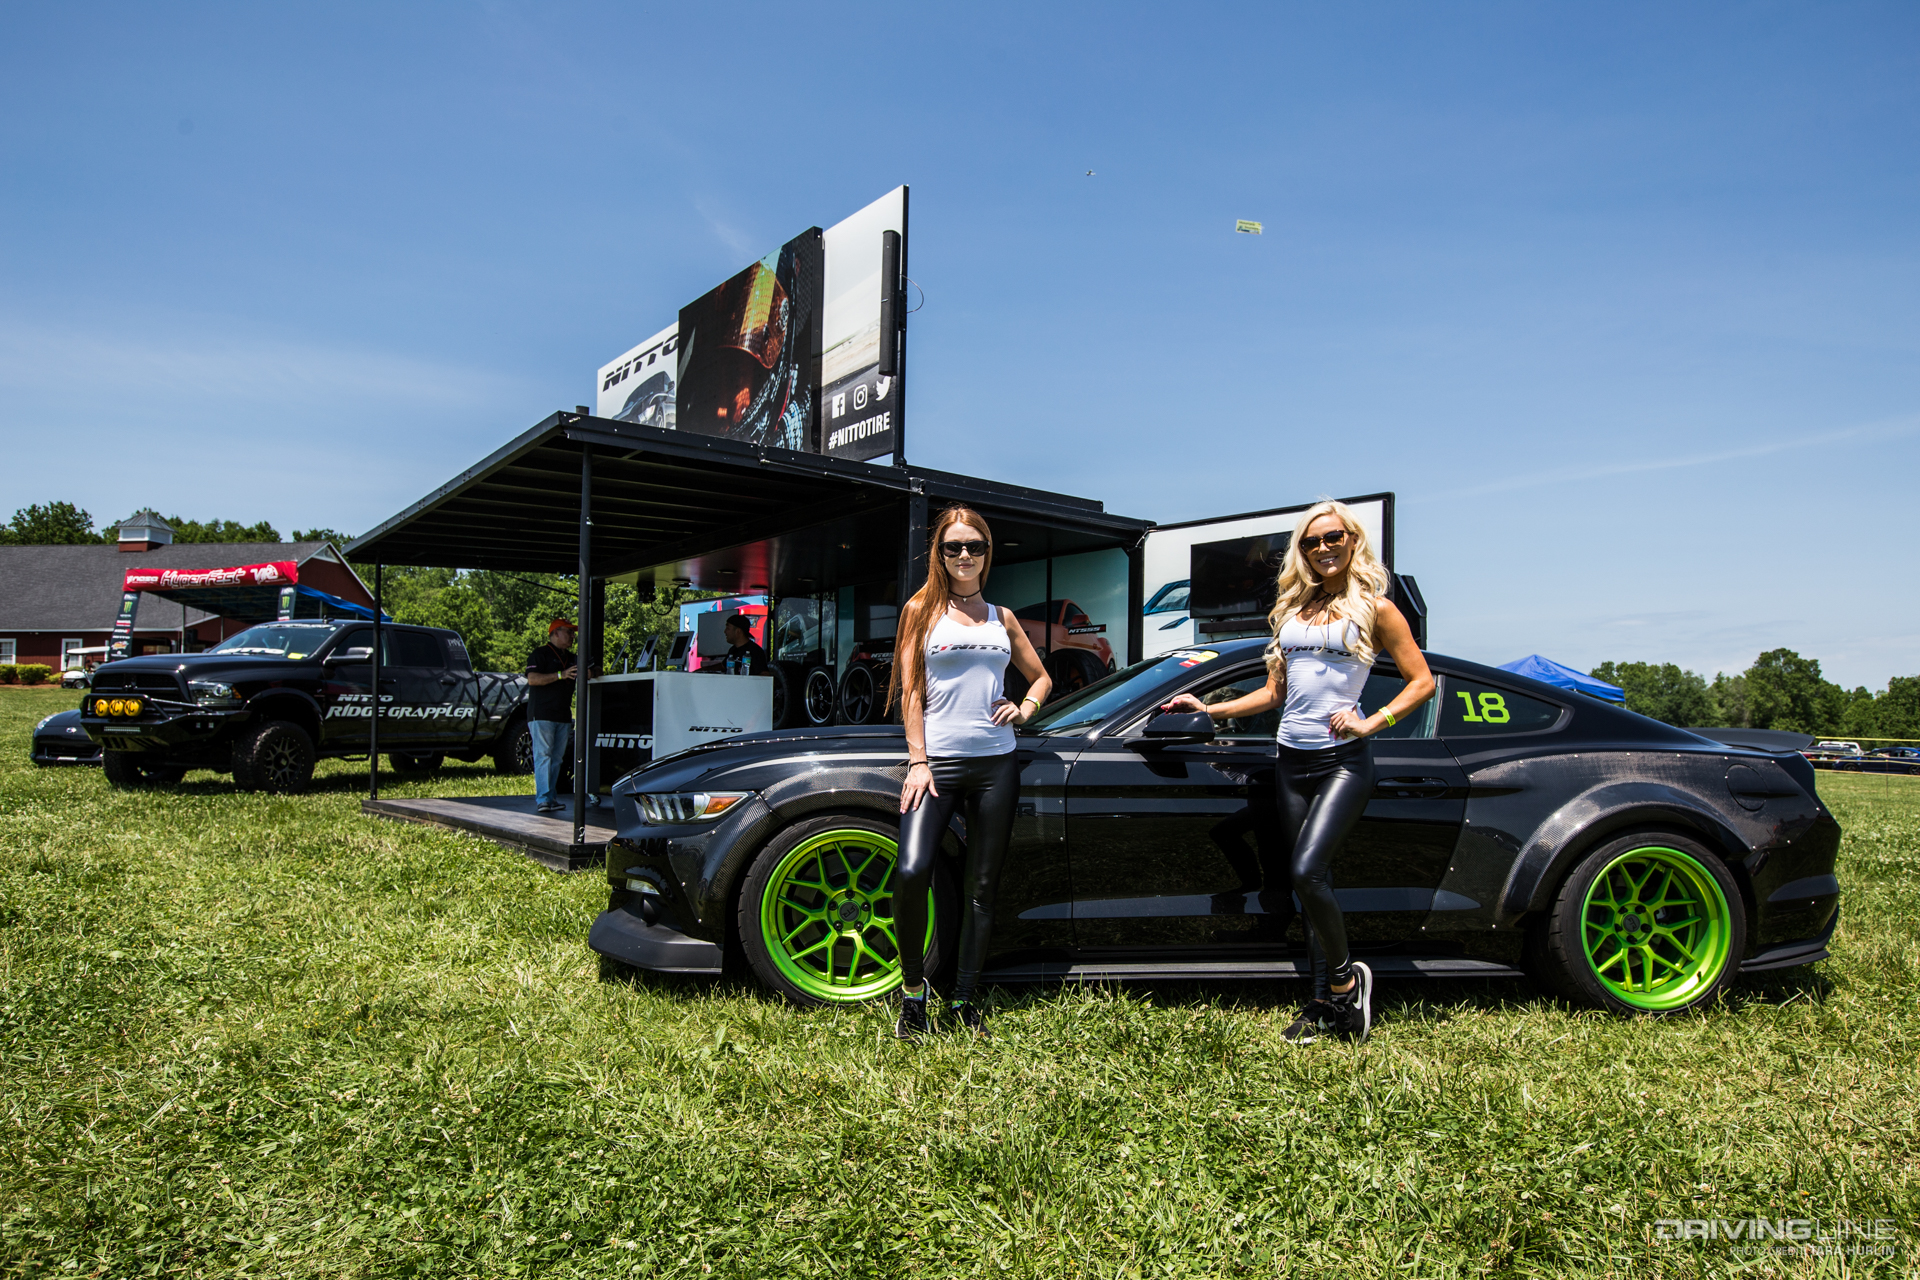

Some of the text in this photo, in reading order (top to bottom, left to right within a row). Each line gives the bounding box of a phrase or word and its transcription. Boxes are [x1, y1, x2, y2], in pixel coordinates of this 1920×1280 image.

[828, 411, 891, 450] #NITTOTIRE
[337, 693, 394, 703] NITO
[325, 703, 475, 720] RIDGE GRAPPLER
[1456, 691, 1511, 723] 18
[687, 725, 743, 733] NITTO
[594, 733, 653, 749] NITTO
